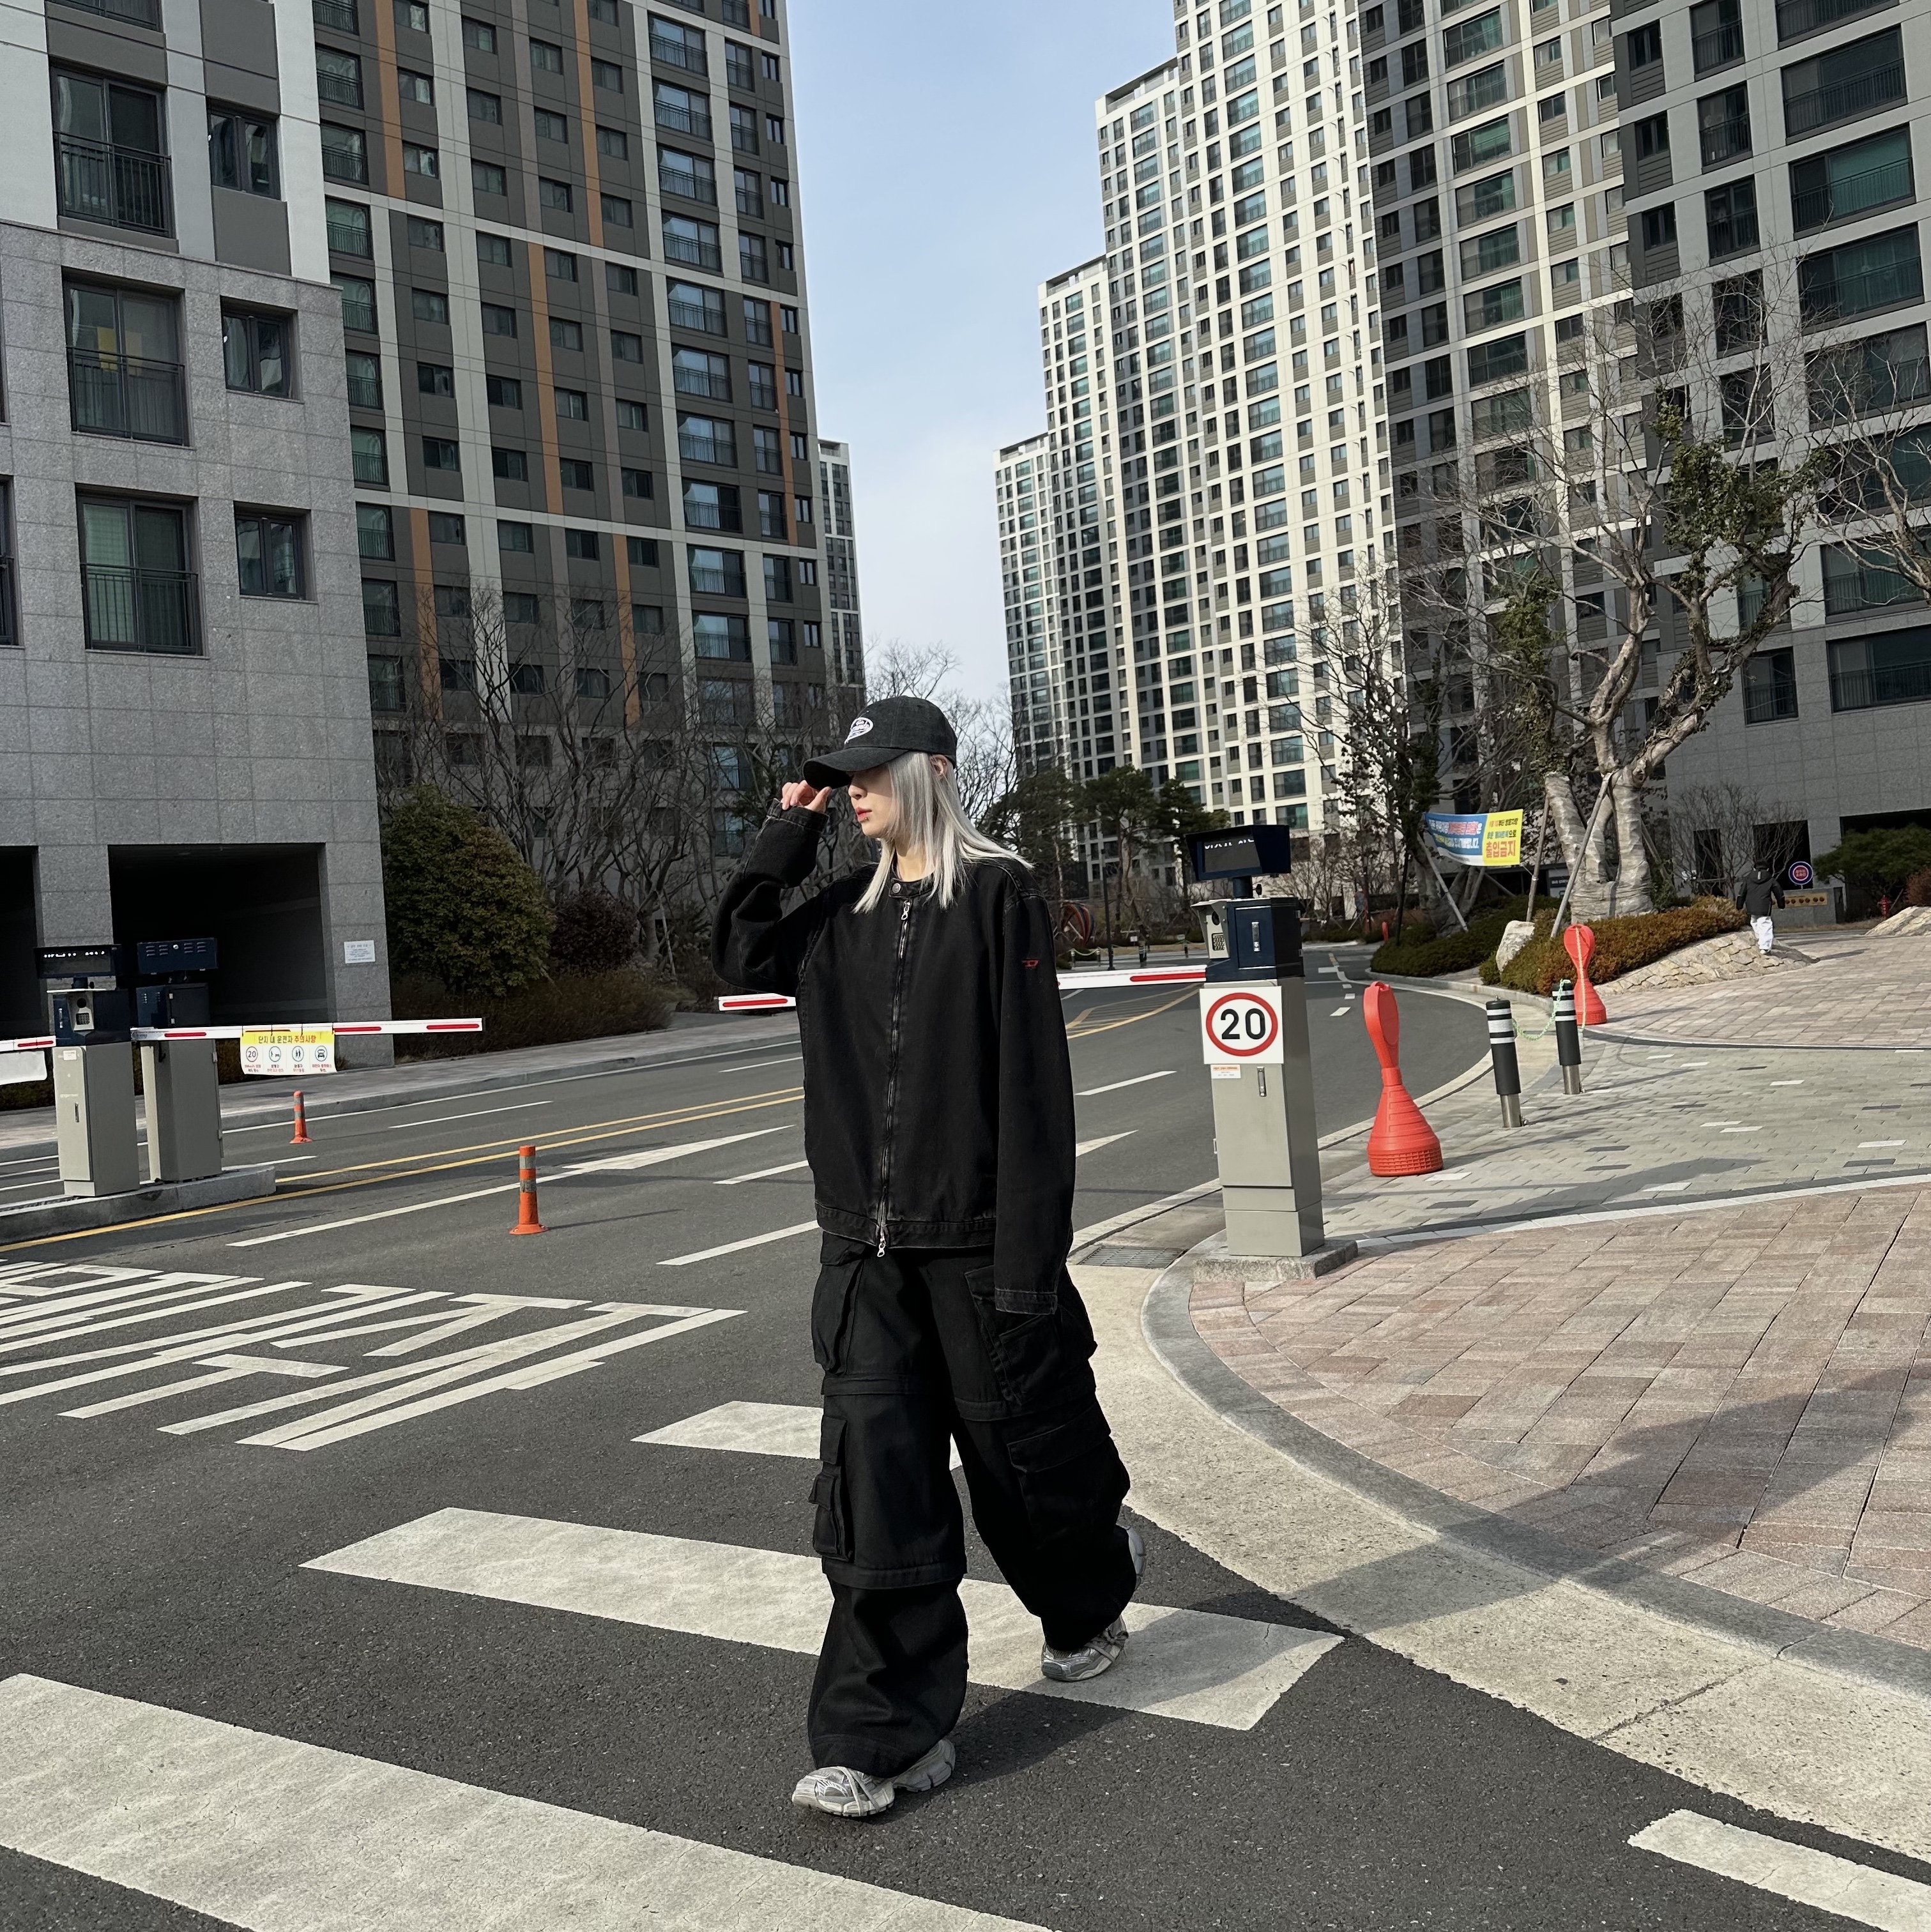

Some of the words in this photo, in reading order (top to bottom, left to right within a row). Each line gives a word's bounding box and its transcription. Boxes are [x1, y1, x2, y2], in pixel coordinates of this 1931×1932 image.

[1486, 840, 1516, 858] 출입금지
[1221, 1008, 1266, 1040] 20
[258, 1035, 268, 1044] 단지
[277, 1035, 293, 1044] 운전자
